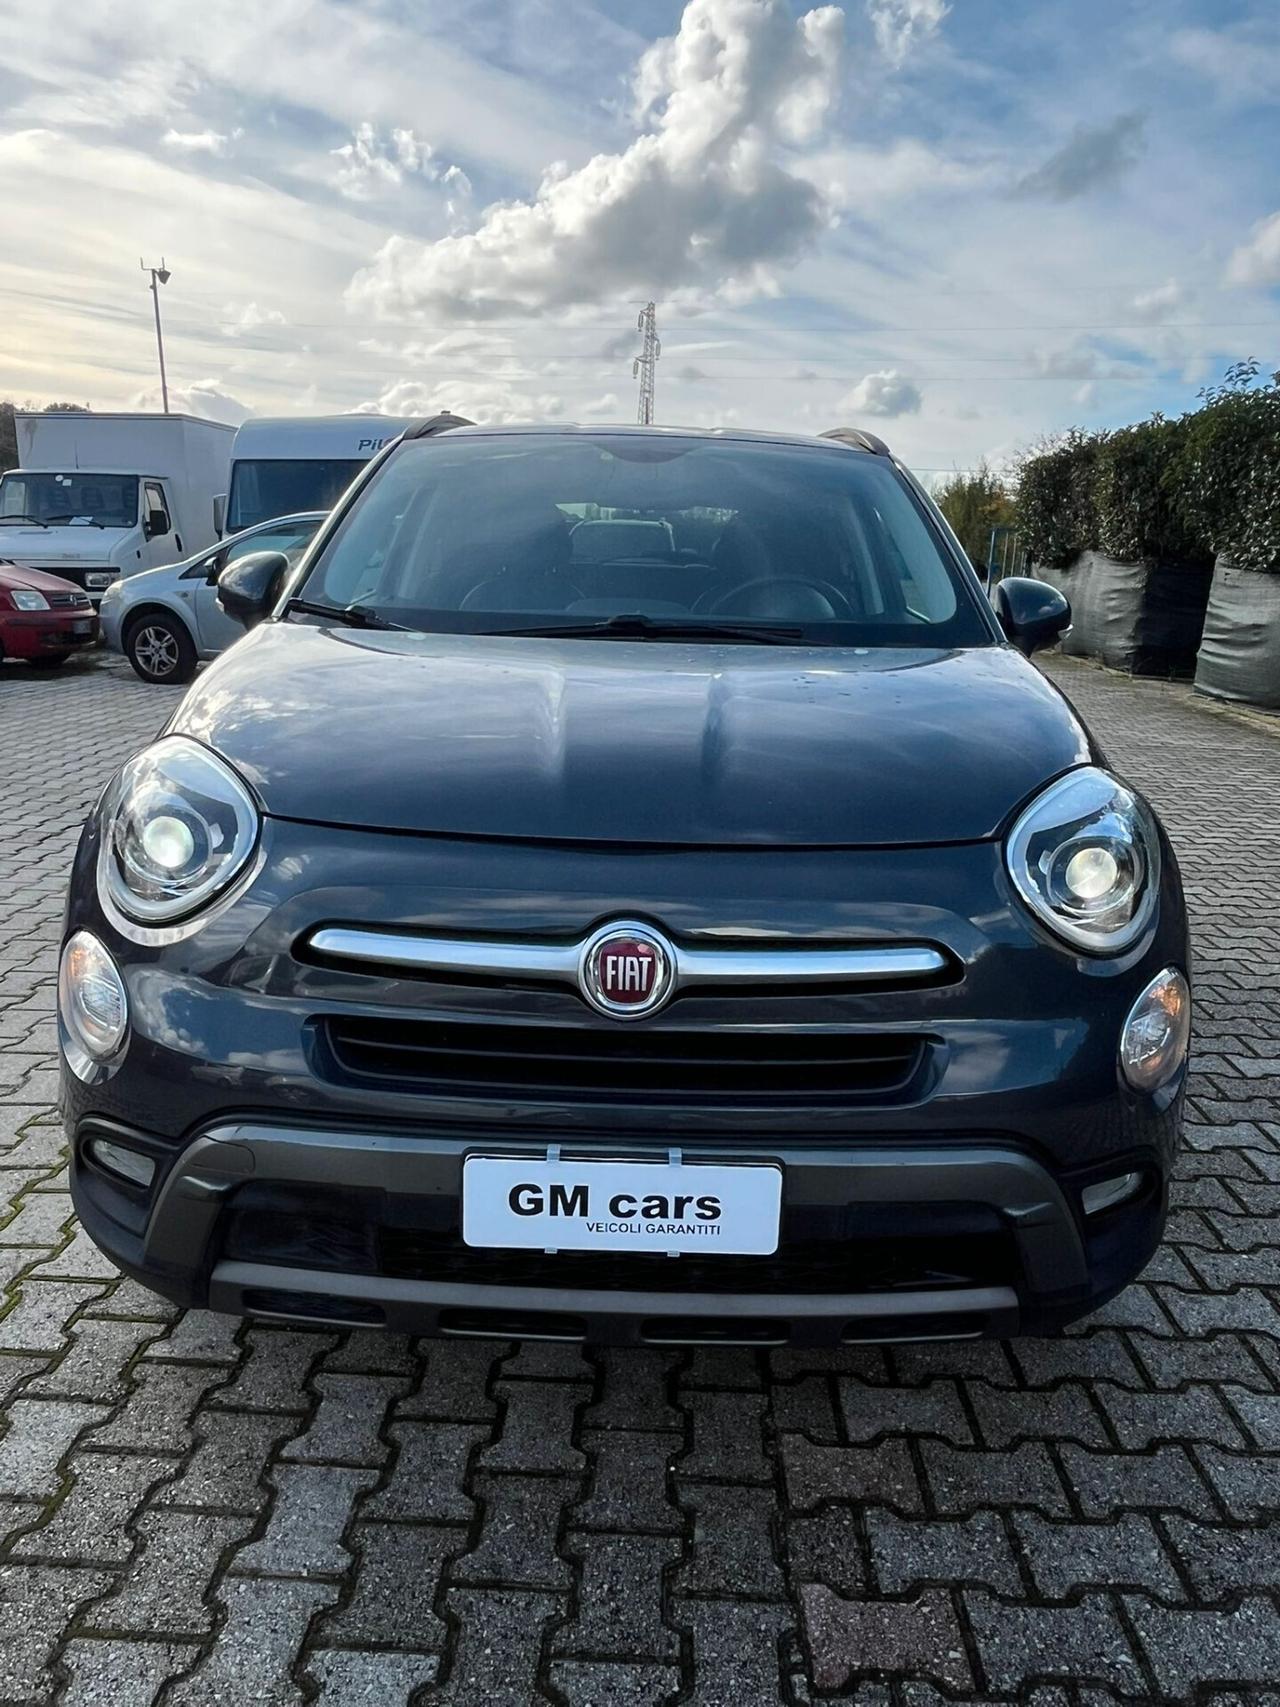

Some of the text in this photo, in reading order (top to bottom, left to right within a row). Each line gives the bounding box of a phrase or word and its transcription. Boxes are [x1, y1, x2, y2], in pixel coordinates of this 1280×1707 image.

[606, 955, 652, 991] FIAT
[508, 1183, 722, 1220] GM cars
[586, 1222, 721, 1235] VEICOLI GARANTITI
